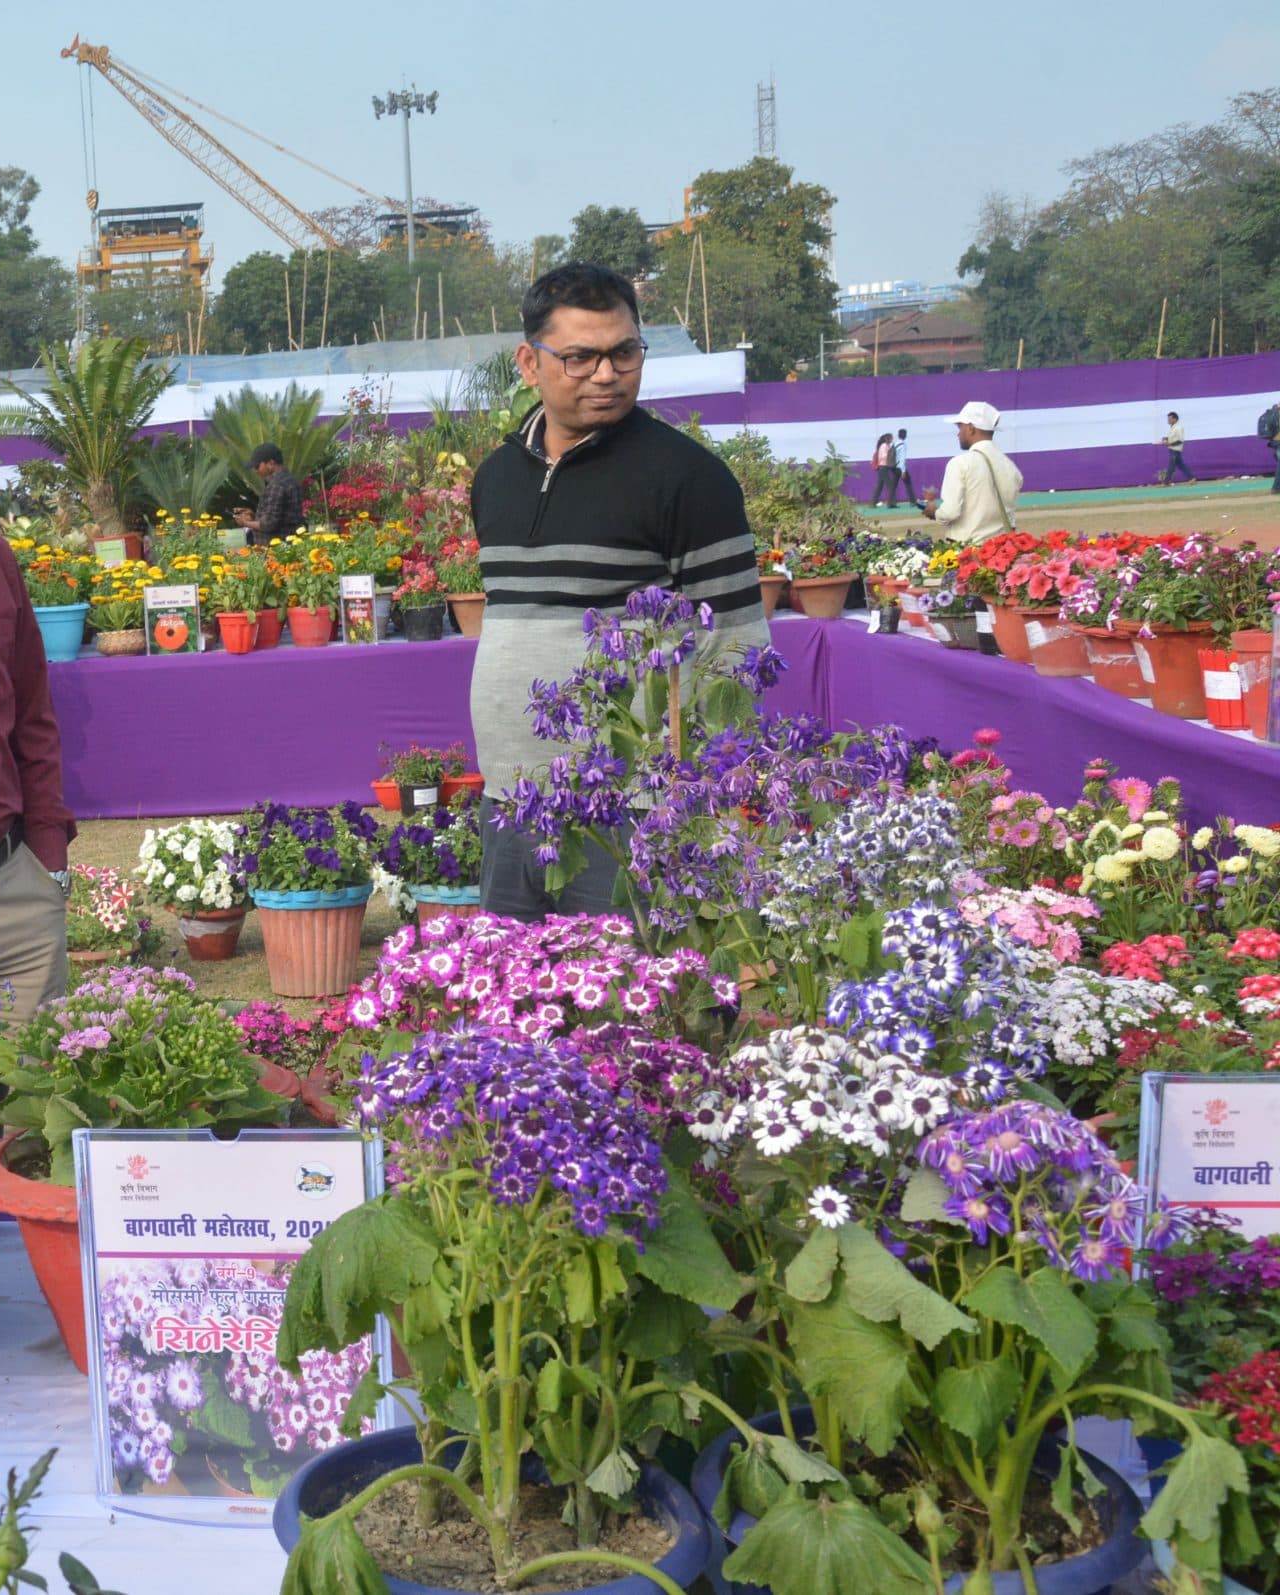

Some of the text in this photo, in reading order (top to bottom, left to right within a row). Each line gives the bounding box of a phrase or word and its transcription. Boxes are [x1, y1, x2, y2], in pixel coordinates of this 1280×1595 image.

[1193, 1161, 1273, 1185] बागवानी
[123, 1213, 331, 1241] बागवानी महोत्सव, 202
[151, 1281, 203, 1303] मौसमी
[209, 1291, 238, 1311] फूल
[154, 1316, 280, 1351] सिनेरेरि
